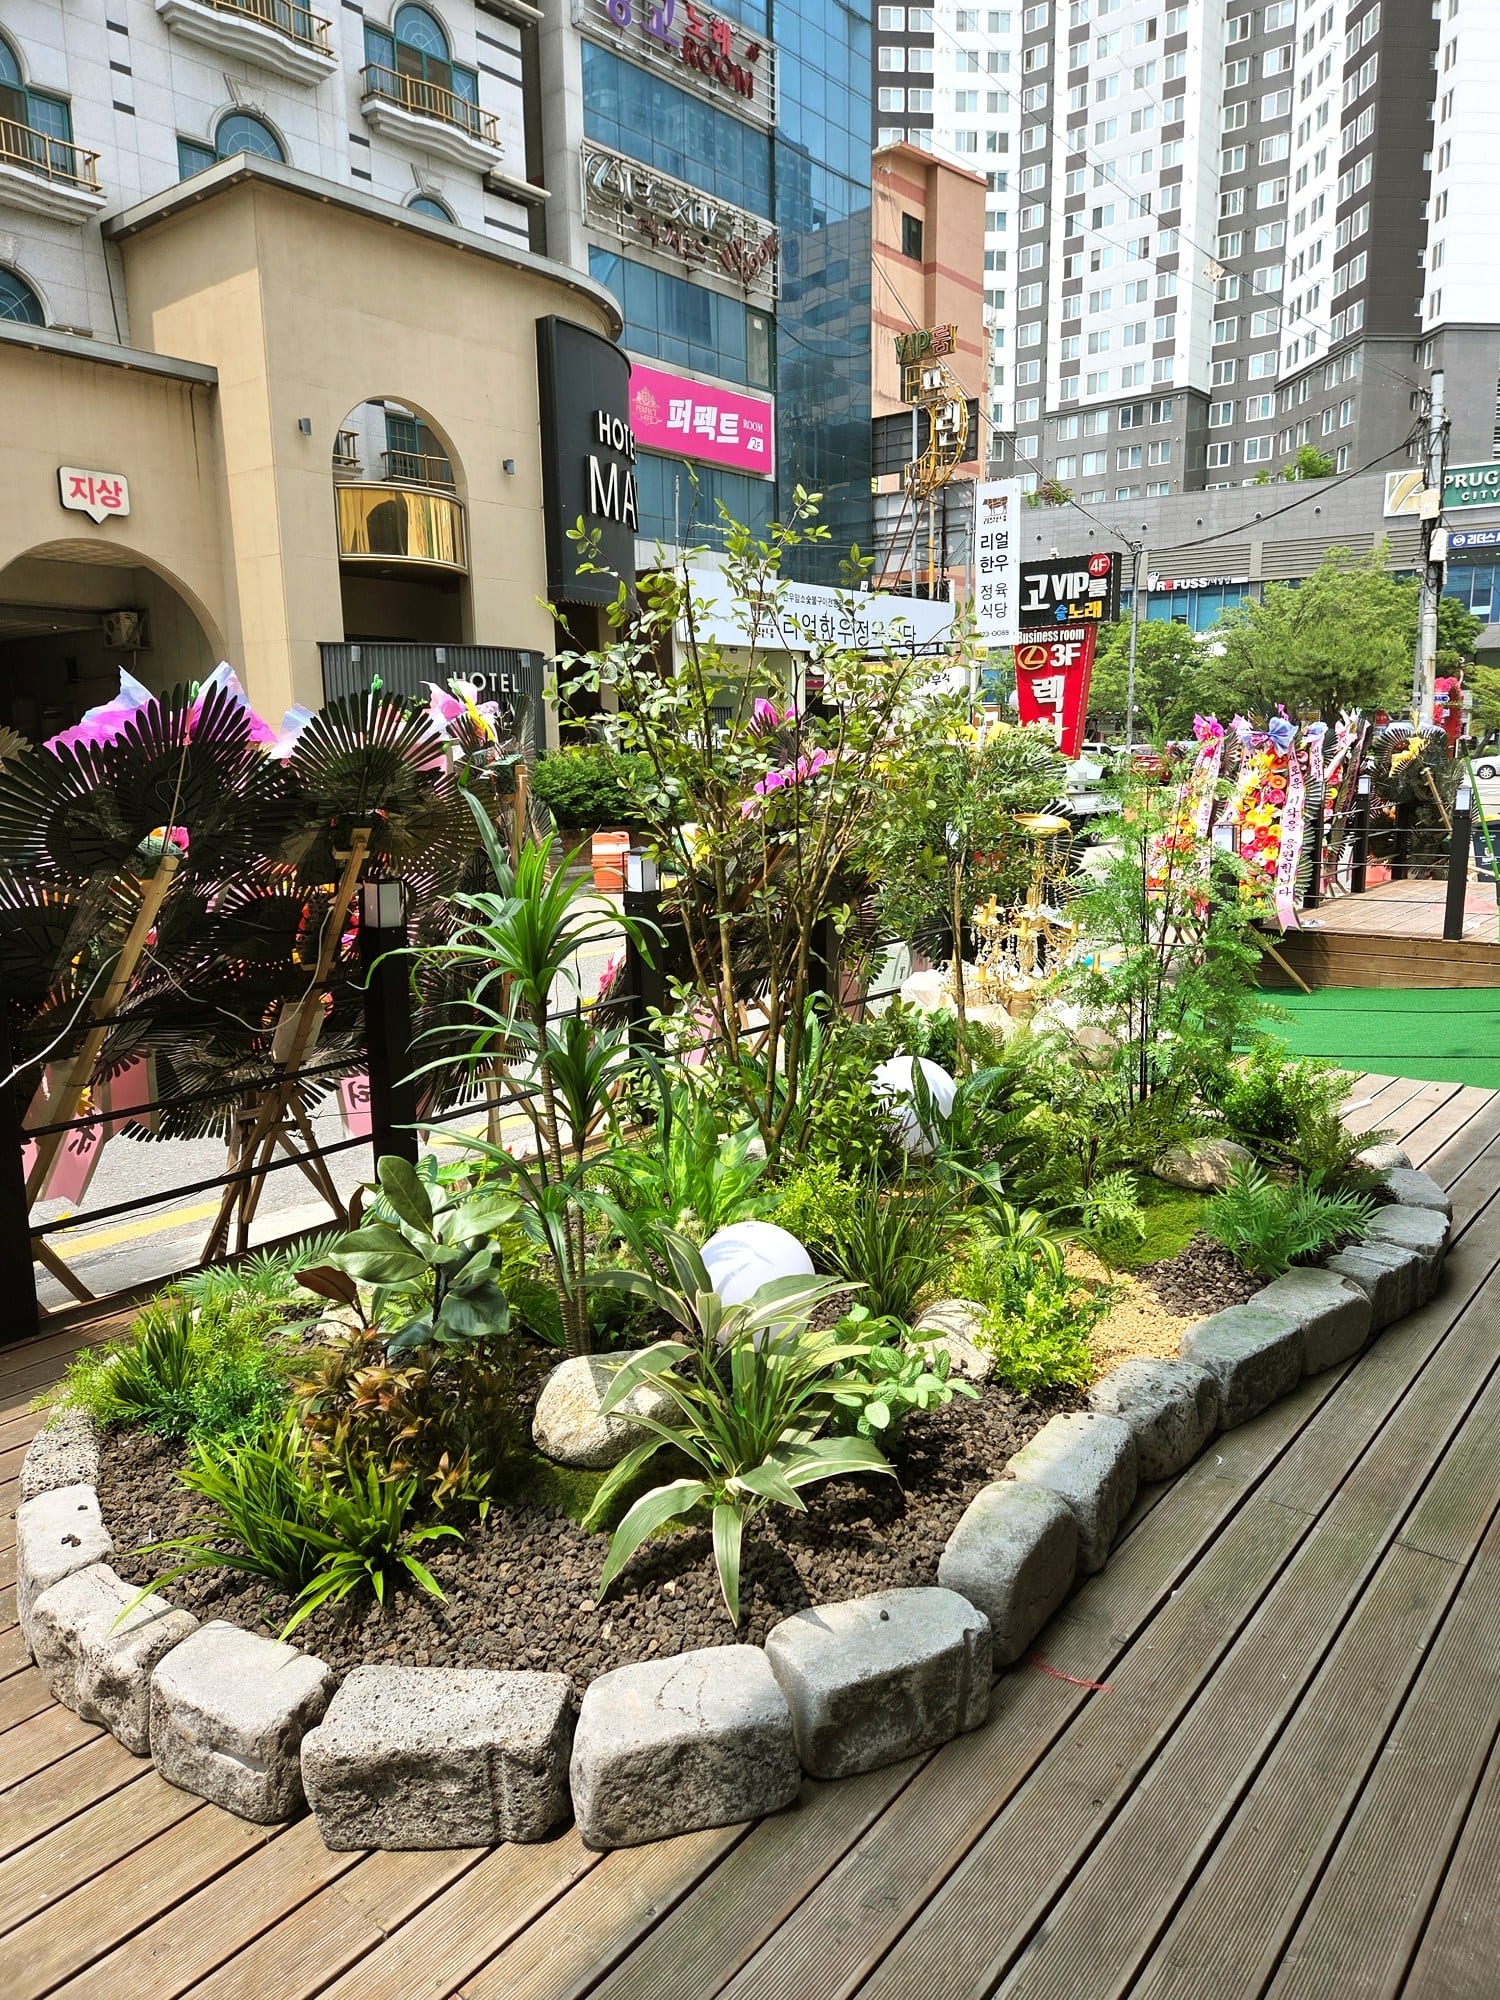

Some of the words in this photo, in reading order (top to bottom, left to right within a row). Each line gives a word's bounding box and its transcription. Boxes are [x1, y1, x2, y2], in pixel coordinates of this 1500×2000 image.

[685, 3, 734, 57] 노래
[683, 35, 754, 99] ROOM
[894, 323, 951, 363] VIP룸
[666, 399, 740, 444] 퍼펙트
[743, 419, 764, 434] ROOM
[598, 410, 638, 465] HOTE
[69, 476, 123, 509] 지상
[589, 455, 638, 531] MA
[1461, 489, 1500, 501] CITY
[980, 531, 1009, 551] 리얼
[980, 554, 1009, 574] 한우
[1089, 558, 1107, 573] 4F
[980, 582, 1009, 601] 정육
[1156, 577, 1209, 592] REFUSS
[980, 602, 1008, 619] 식당
[1018, 629, 1059, 645] Business
[1060, 628, 1085, 642] room
[1050, 643, 1081, 668] 3F
[453, 671, 520, 693] HOTEL
